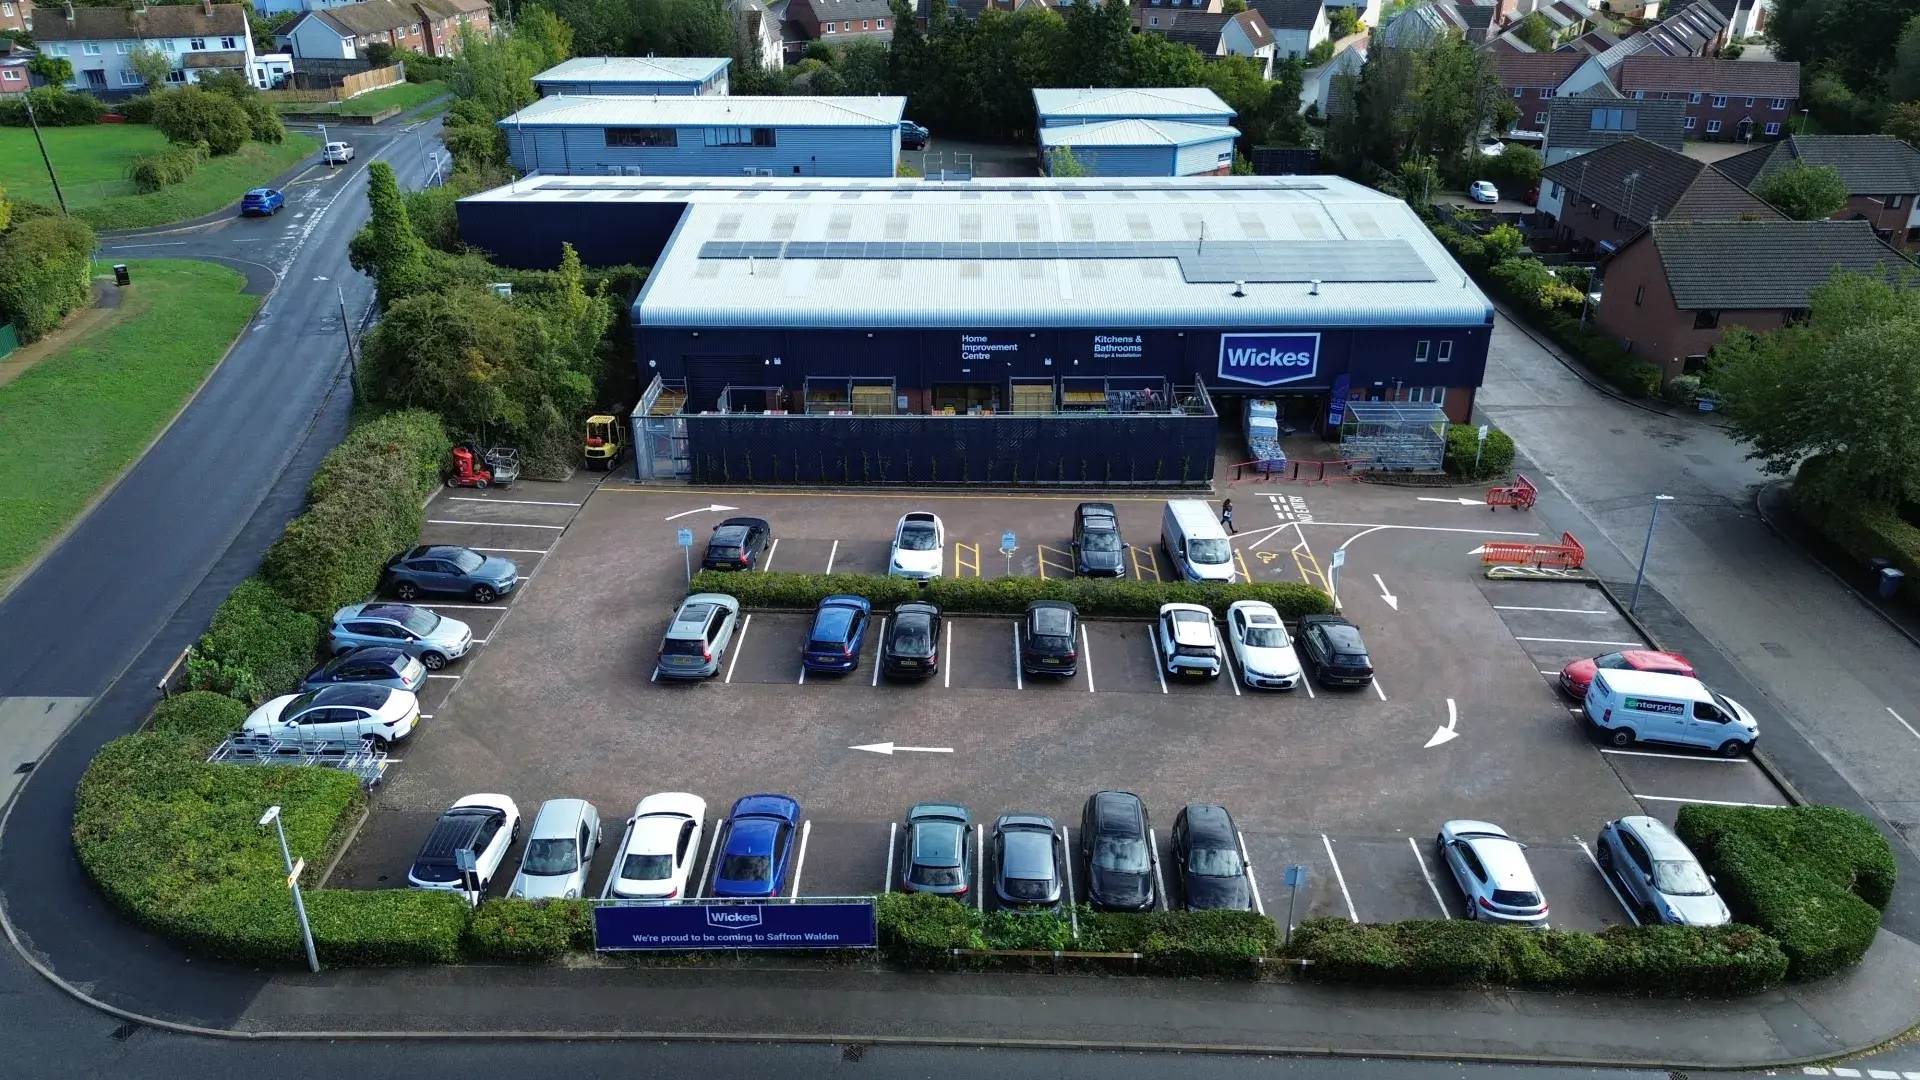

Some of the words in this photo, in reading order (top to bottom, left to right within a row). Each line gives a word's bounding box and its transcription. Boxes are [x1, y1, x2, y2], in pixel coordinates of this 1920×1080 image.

[1095, 335, 1133, 343] Kitchens
[1135, 335, 1142, 343] &
[962, 343, 1018, 352] Improvement
[1094, 344, 1142, 352] Bathrooms
[962, 352, 990, 360] Centre
[1227, 348, 1310, 367] Wickes
[1628, 699, 1683, 712] enterprise
[710, 912, 758, 922] Wickes
[633, 934, 658, 942] We're
[661, 934, 688, 943] proud
[691, 934, 700, 942] to
[717, 933, 752, 943] coming
[767, 933, 802, 941] Saffron
[804, 932, 839, 941] Walden
